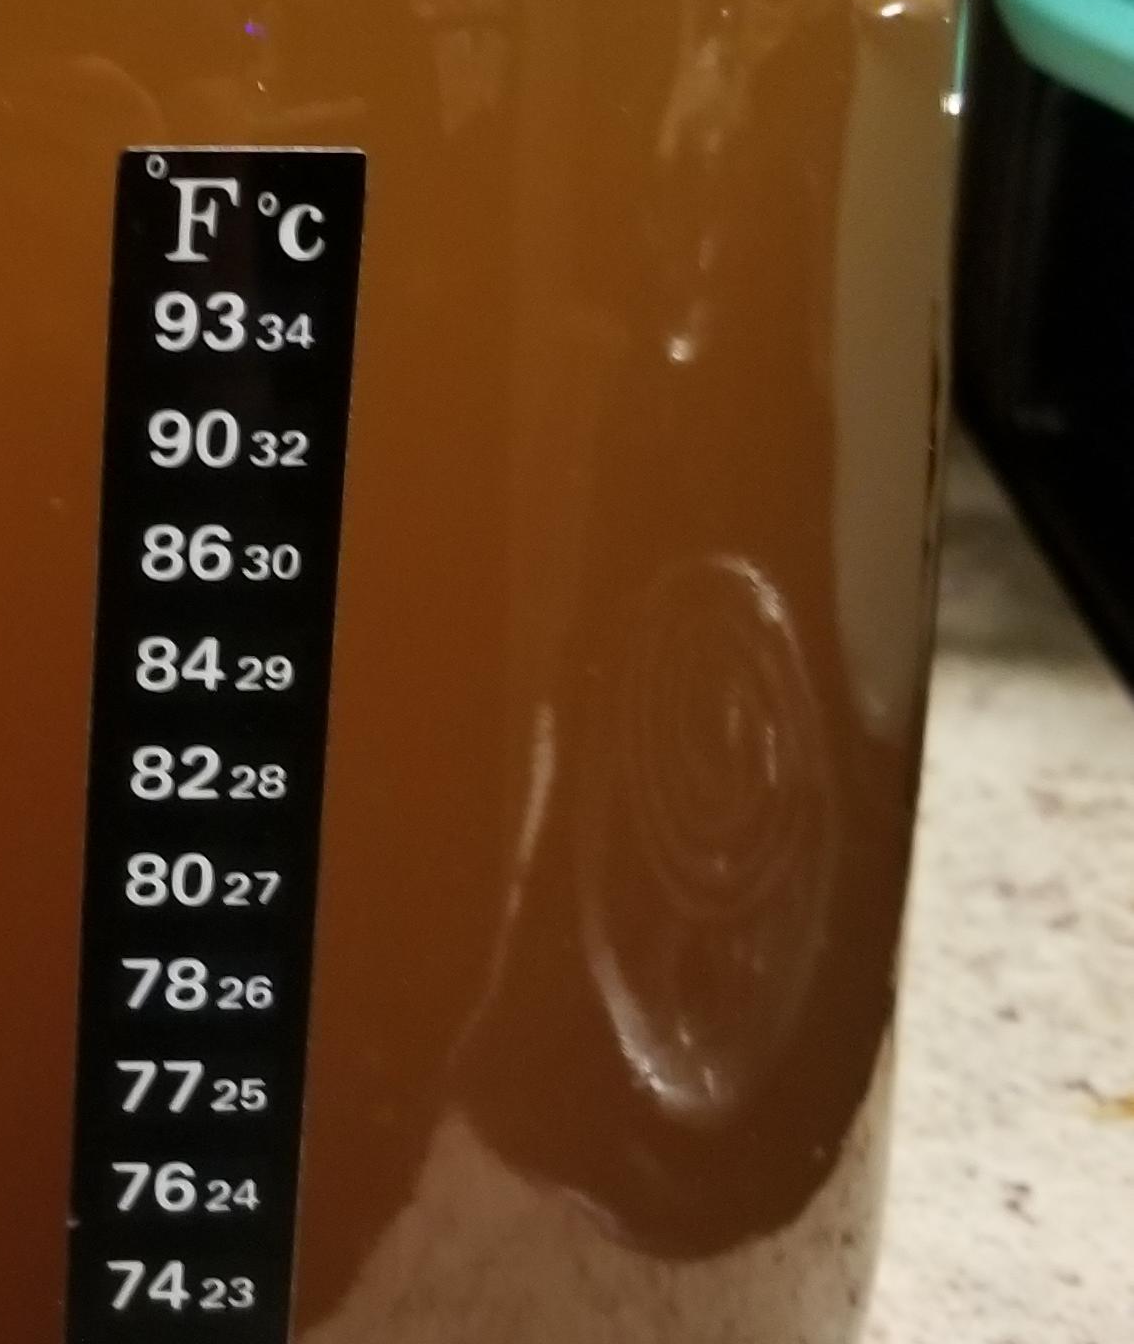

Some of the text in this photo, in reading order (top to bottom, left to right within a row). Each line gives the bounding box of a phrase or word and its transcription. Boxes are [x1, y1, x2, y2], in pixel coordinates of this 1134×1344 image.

[154, 291, 316, 353] 93 34
[147, 408, 310, 469] 90 32
[140, 523, 302, 582] 86 30
[135, 635, 295, 693] 84 29
[129, 744, 288, 801] 82 28
[124, 851, 282, 908] 80 27
[120, 957, 274, 1012] 78 26
[115, 1059, 268, 1114] 77 25
[111, 1160, 261, 1213] 76 24
[106, 1259, 256, 1311] 74 23
